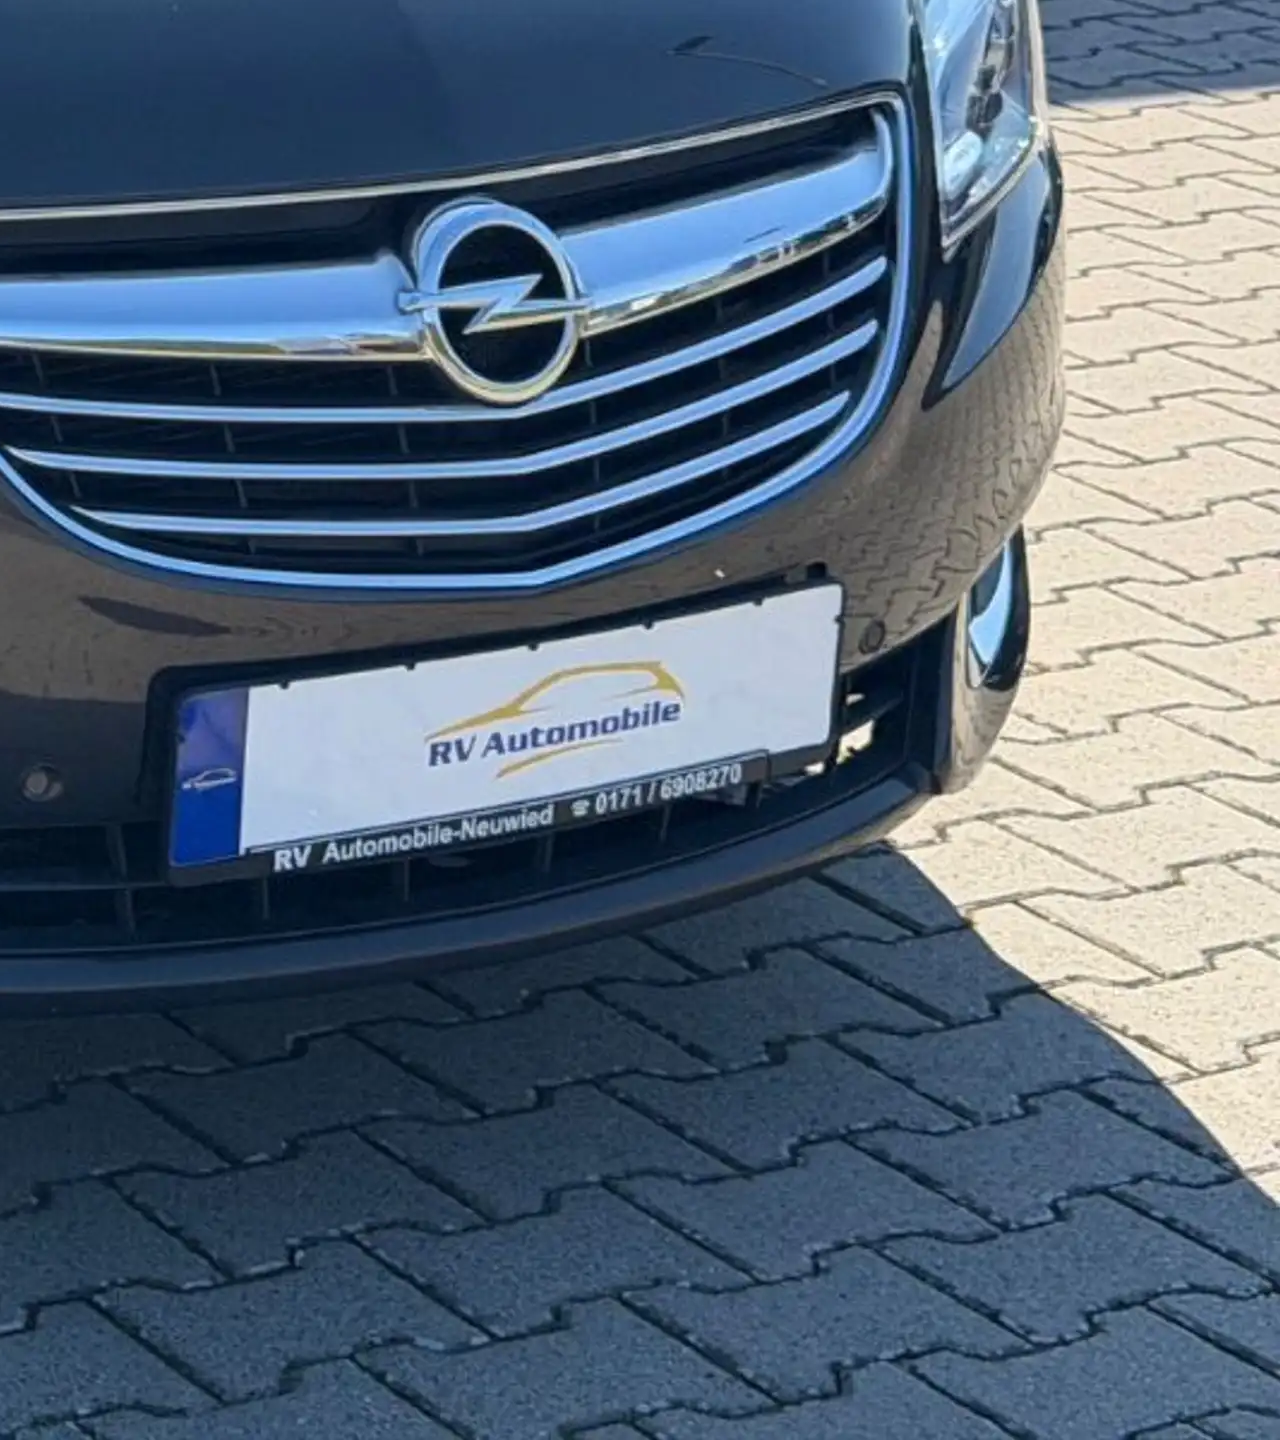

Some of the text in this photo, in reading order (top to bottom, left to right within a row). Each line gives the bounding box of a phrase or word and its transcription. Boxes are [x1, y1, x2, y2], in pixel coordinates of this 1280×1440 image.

[428, 701, 680, 767] RV Automobile
[274, 845, 313, 872] RV
[322, 804, 555, 864] Automobile-Neuwied
[595, 786, 641, 814] 0171
